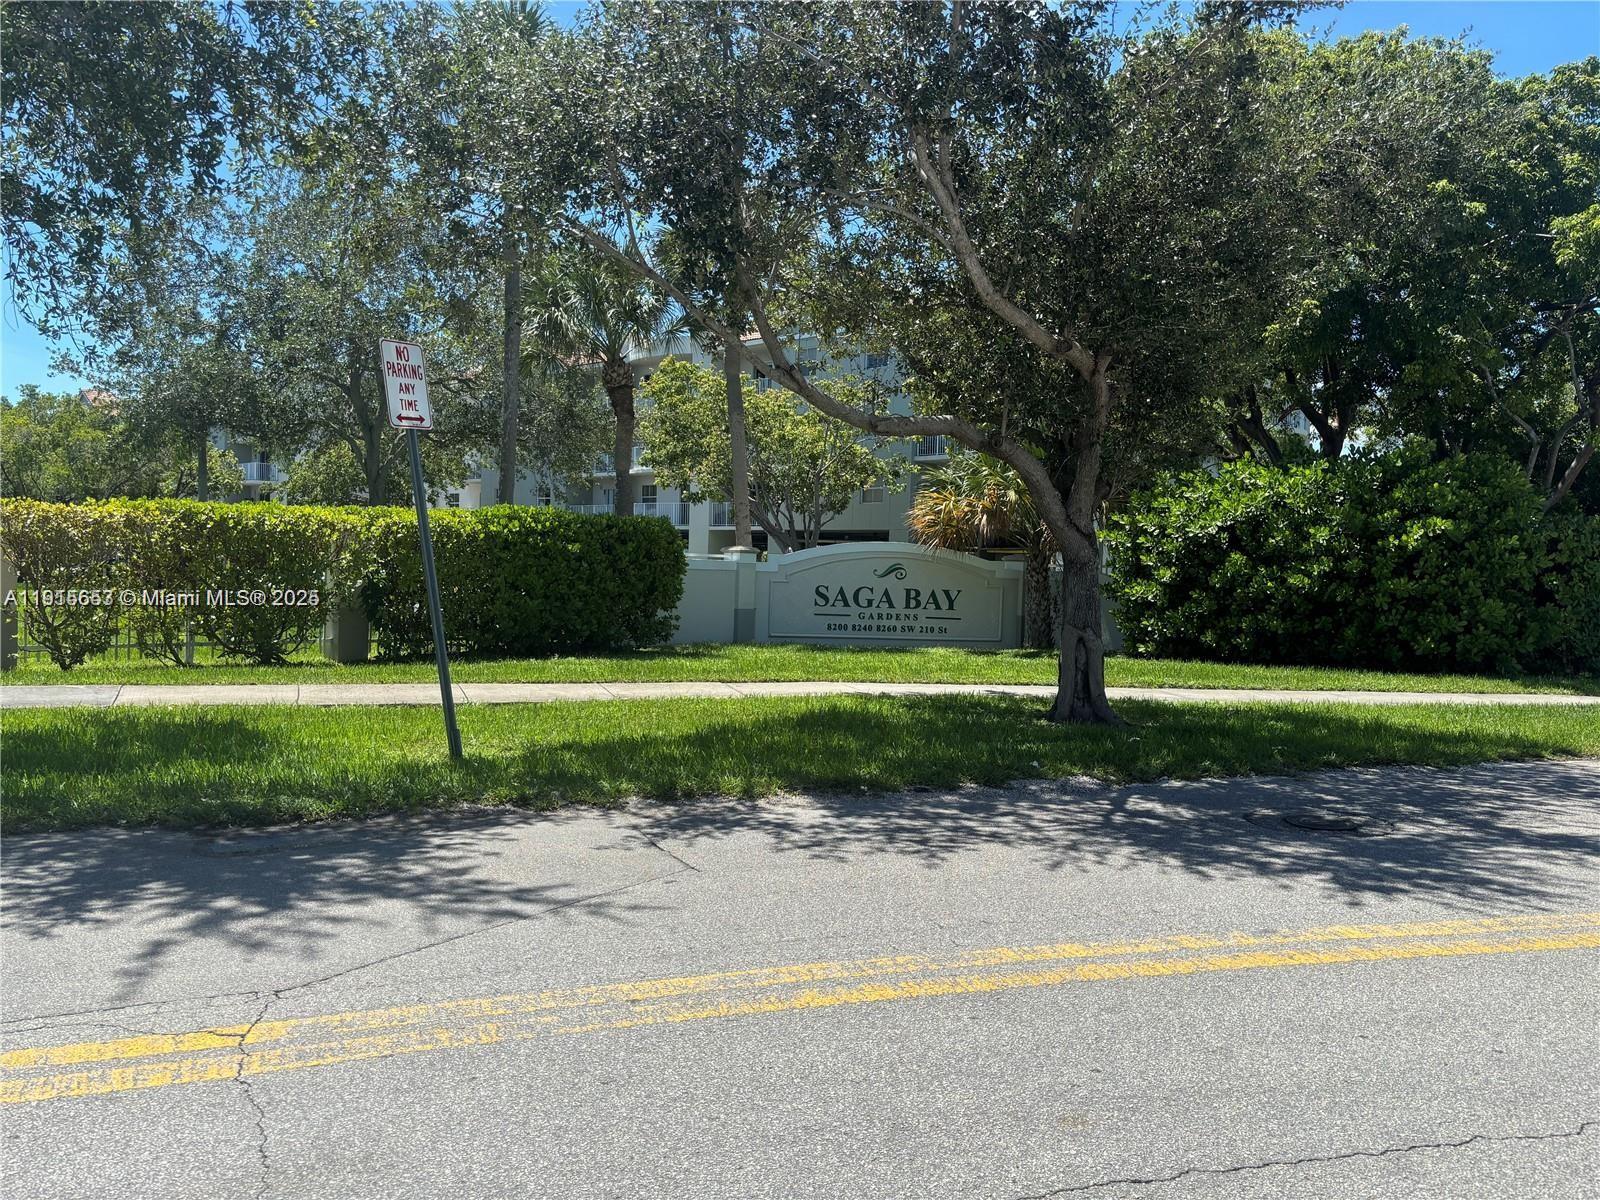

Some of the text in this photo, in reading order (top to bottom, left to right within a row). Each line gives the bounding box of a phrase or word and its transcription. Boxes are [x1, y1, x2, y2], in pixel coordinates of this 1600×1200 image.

[395, 345, 409, 362] NO
[386, 361, 423, 381] PARKING
[399, 383, 415, 395] ANY
[399, 399, 419, 412] TIME
[814, 584, 963, 611] SAGA BAY
[858, 611, 919, 621] GARDENS
[826, 623, 948, 634] 8200 8240 8260 SW 210 St
